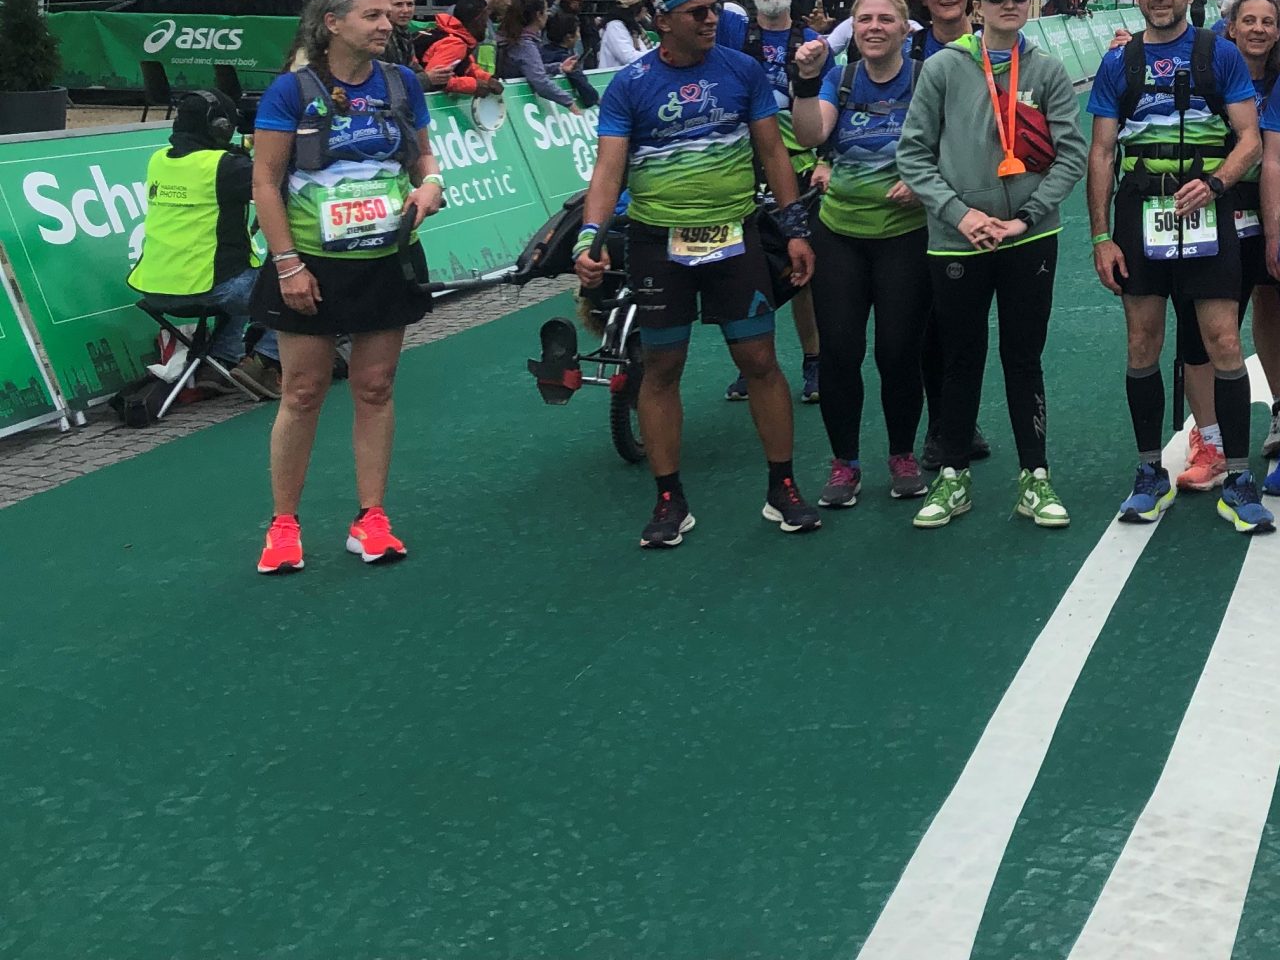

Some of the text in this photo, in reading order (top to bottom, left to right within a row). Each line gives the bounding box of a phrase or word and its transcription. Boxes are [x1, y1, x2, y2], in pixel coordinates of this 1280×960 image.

[176, 28, 243, 50] asics
[171, 56, 195, 64] sound
[213, 58, 236, 66] sound
[237, 59, 258, 67] body
[524, 102, 600, 150] Schne
[160, 191, 187, 199] PHOTOS
[338, 182, 388, 193] Schneider
[442, 169, 516, 209] lectric
[330, 198, 388, 226] 57350
[680, 225, 730, 244] 49629
